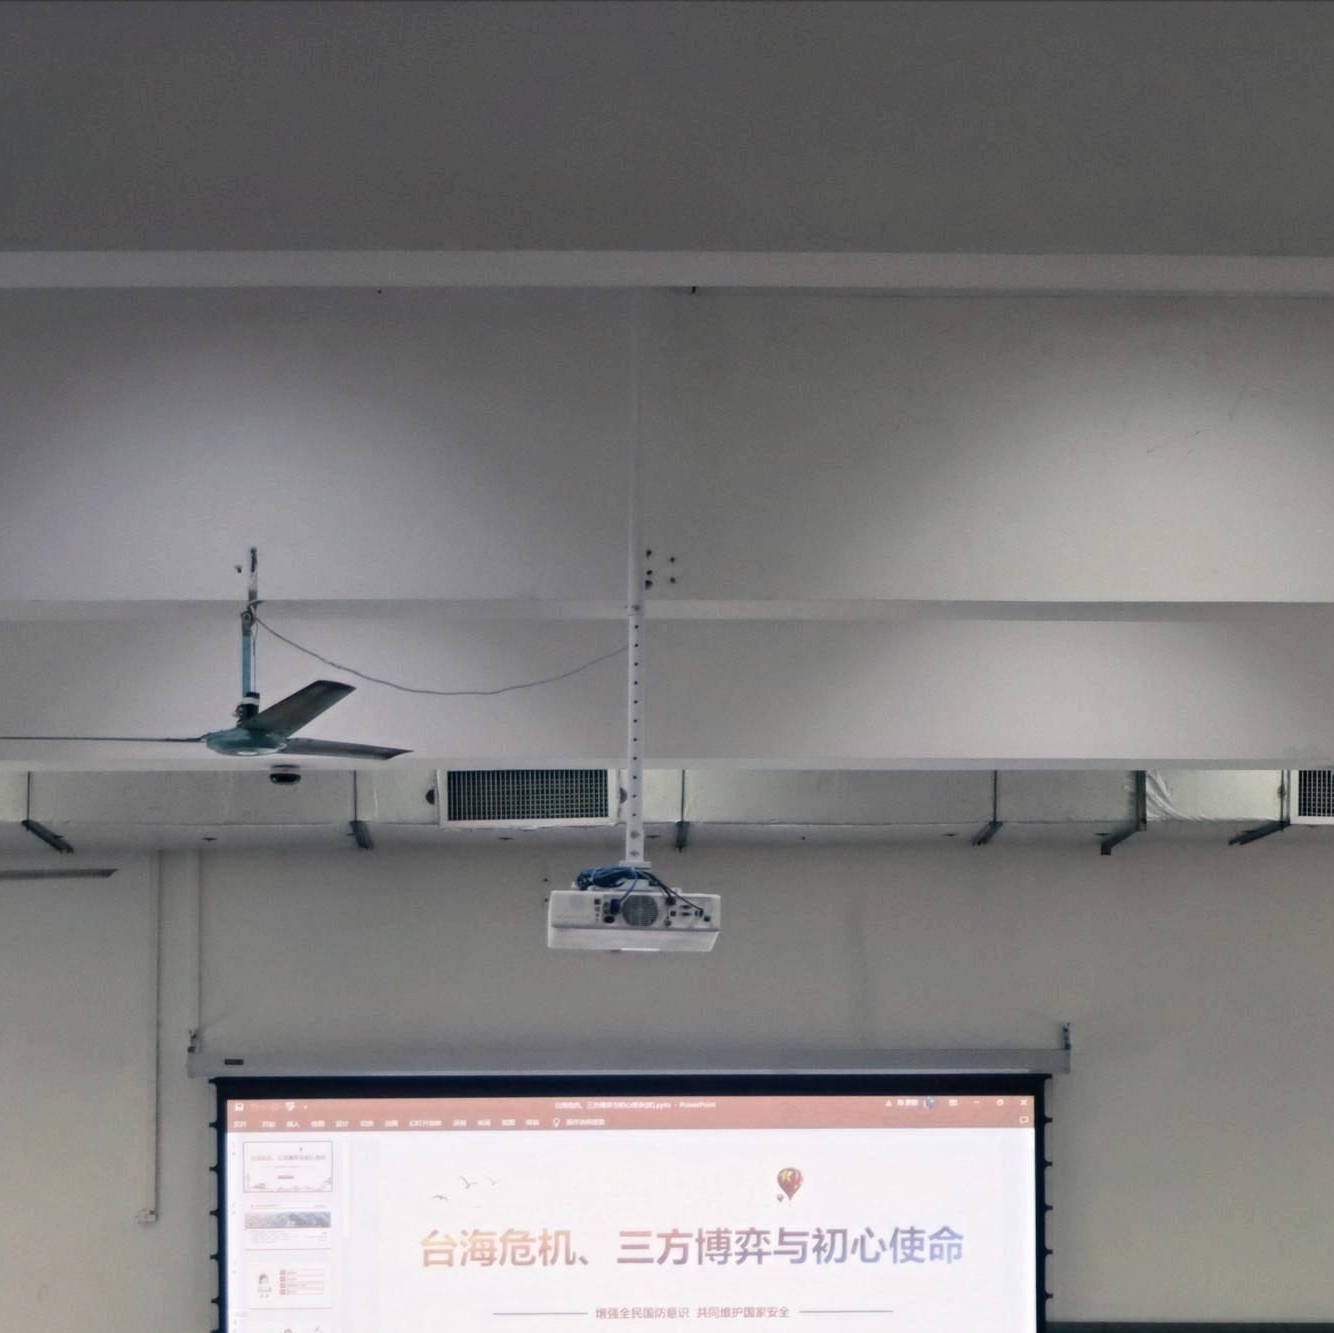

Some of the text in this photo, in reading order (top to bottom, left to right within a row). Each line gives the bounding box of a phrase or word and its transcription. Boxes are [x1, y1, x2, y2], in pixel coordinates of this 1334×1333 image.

[420, 1225, 964, 1268] 台海危机、三方博弈与初心使命
[596, 1306, 790, 1319] 增强全民国防意识 共同维护国家安全
